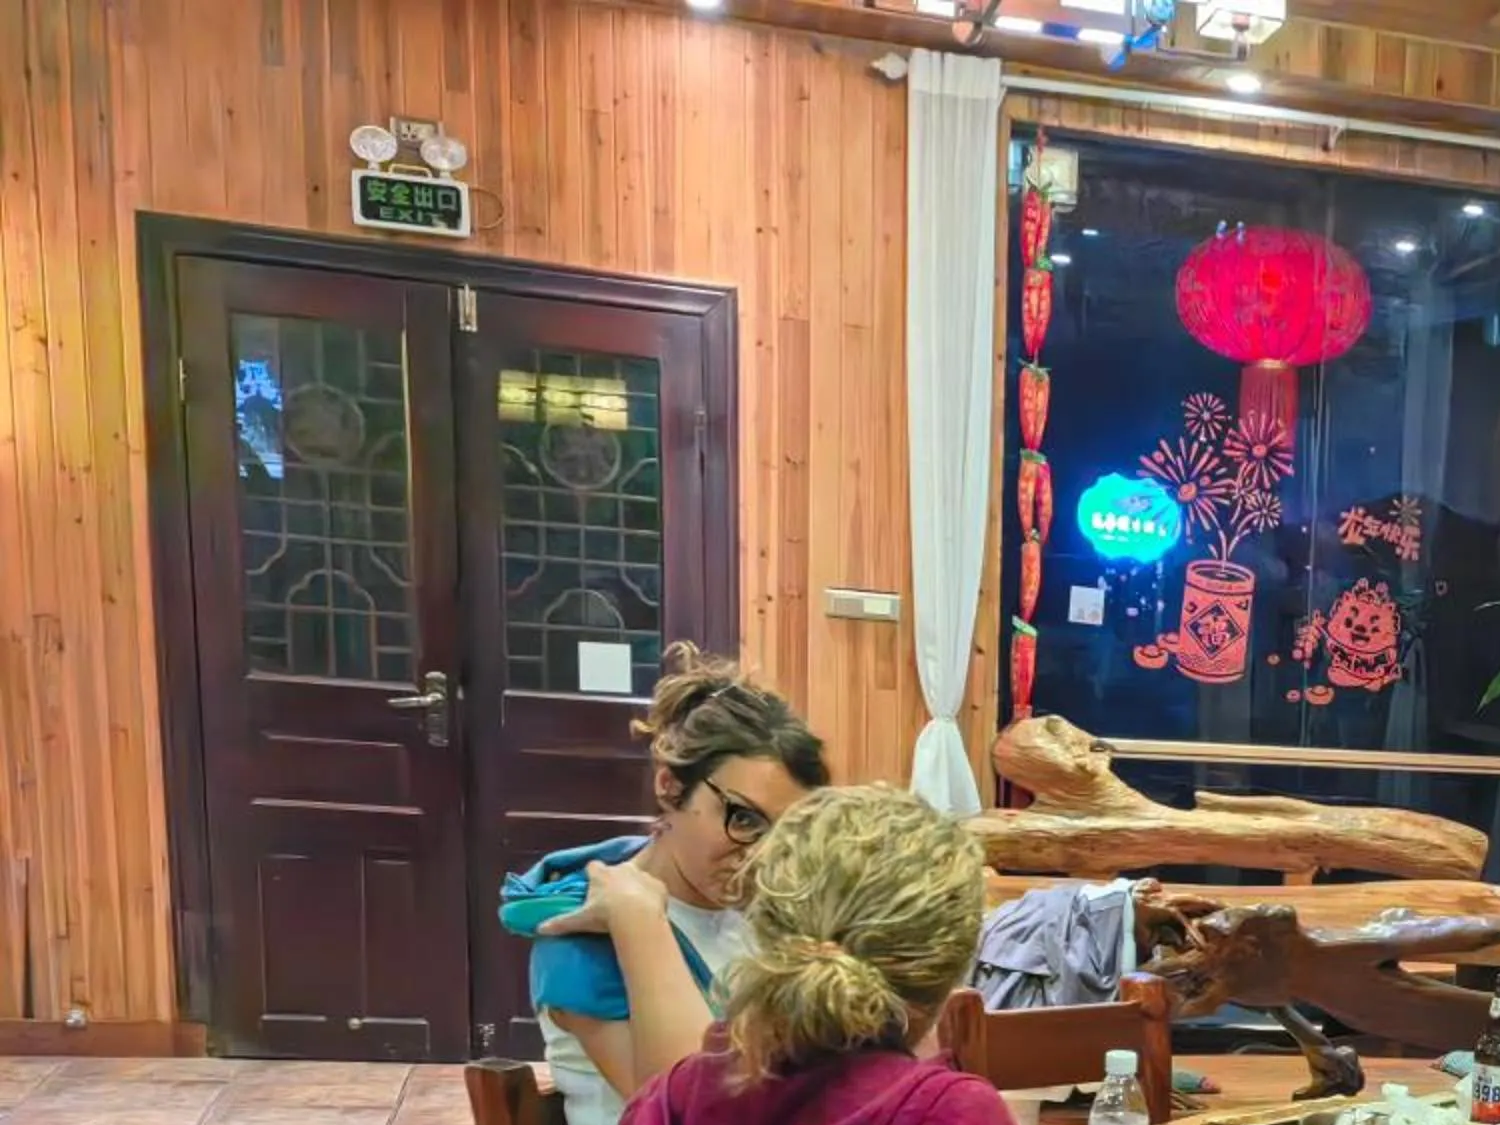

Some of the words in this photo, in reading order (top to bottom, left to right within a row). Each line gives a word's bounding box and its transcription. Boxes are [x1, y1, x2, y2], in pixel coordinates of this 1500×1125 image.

[366, 179, 458, 212] 安全出口
[379, 206, 443, 225] EXIT
